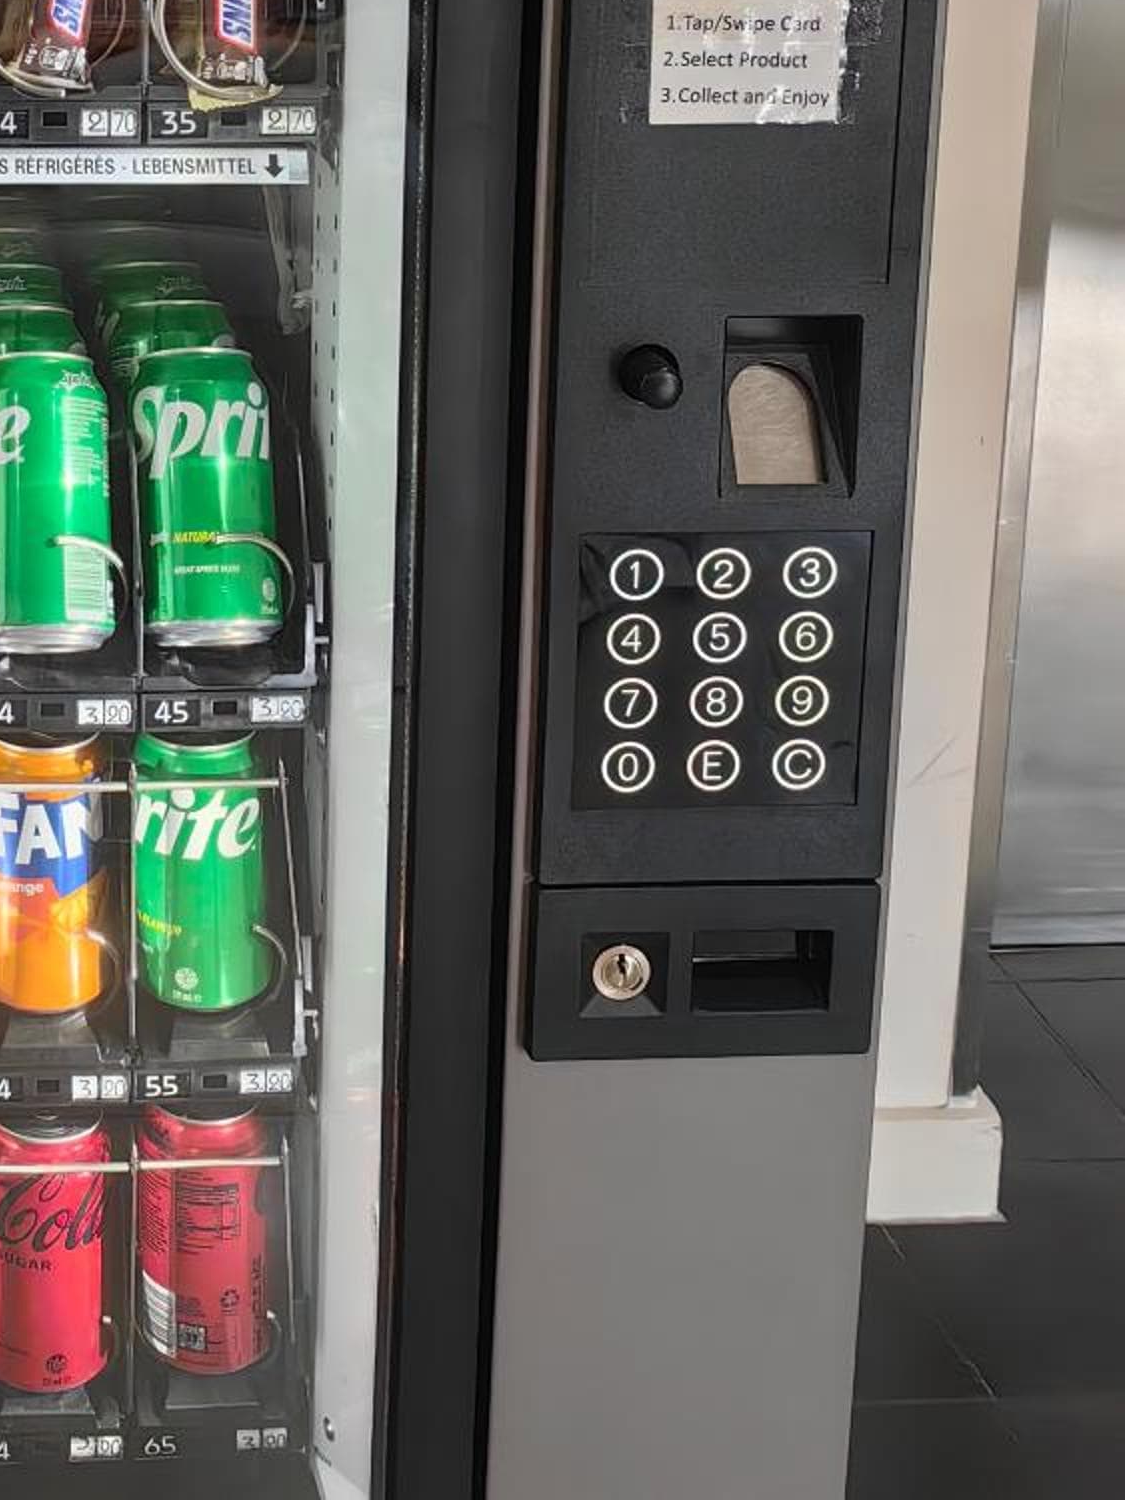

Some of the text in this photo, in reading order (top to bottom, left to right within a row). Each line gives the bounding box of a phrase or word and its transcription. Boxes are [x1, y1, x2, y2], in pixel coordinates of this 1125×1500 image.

[739, 52, 808, 69] Product
[782, 89, 830, 110] Enjoy
[160, 110, 197, 135] 35
[132, 157, 257, 174] LEBENSMITTEL
[629, 560, 640, 590] 1
[713, 559, 734, 589] 2
[799, 558, 821, 588] 3
[620, 624, 642, 653] 4
[709, 623, 731, 652] 5
[795, 622, 817, 651] 6
[154, 701, 189, 725] 45
[621, 689, 640, 717] 7
[706, 687, 727, 717] 8
[792, 685, 814, 715] 9
[618, 752, 639, 782] 0
[702, 751, 723, 781] E
[784, 750, 813, 780] C
[144, 1075, 178, 1097] 55
[143, 1435, 177, 1456] 65
